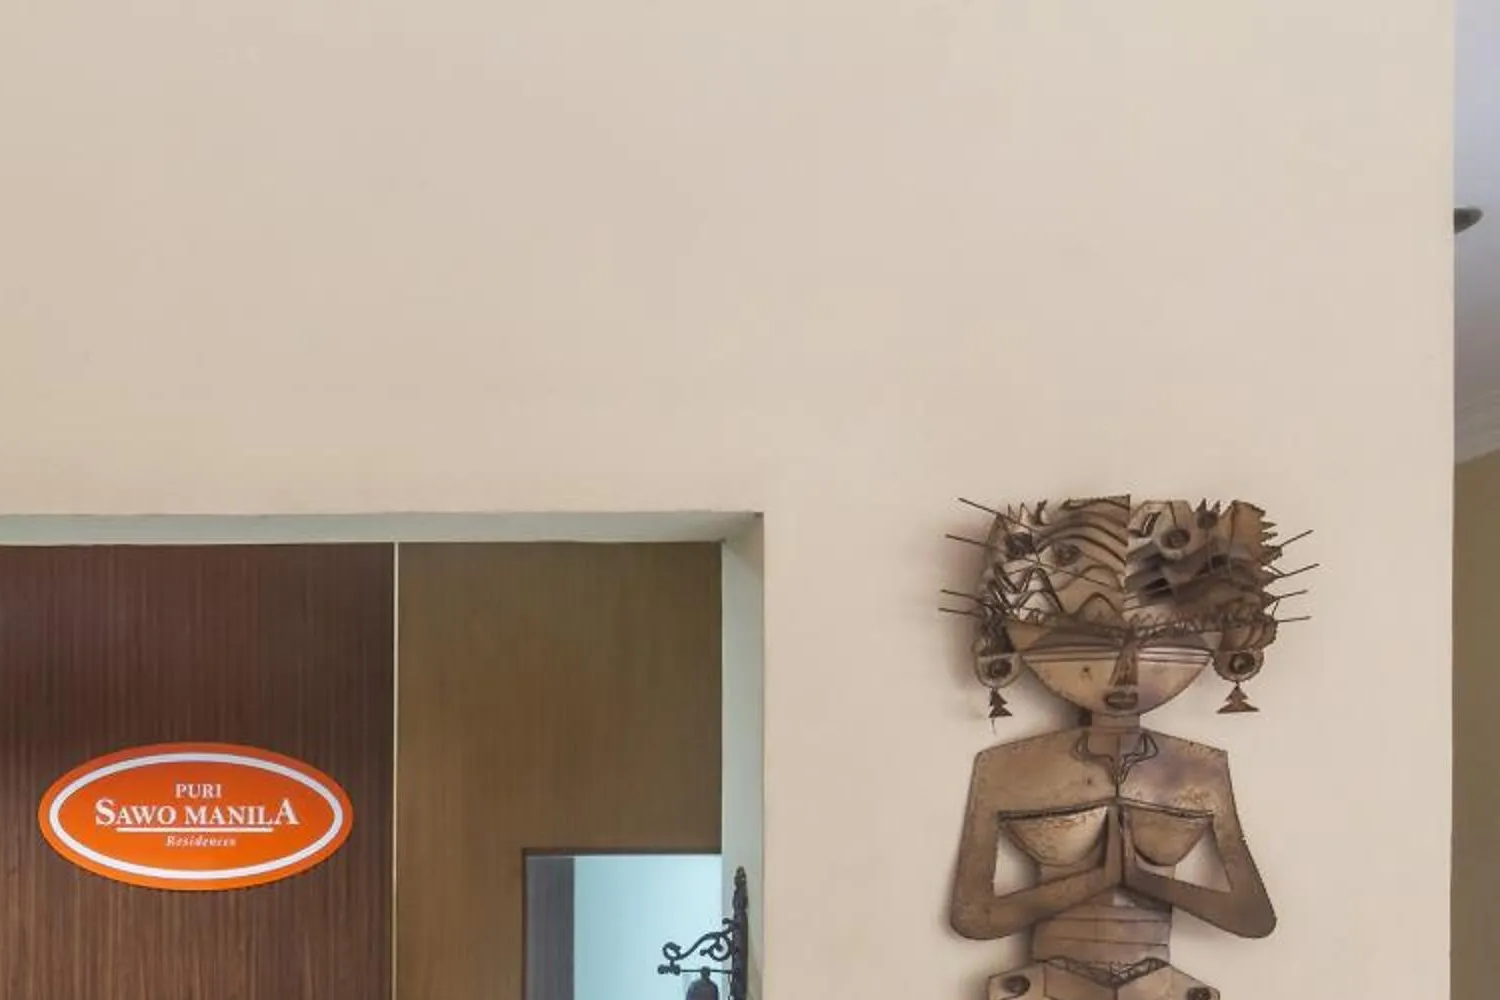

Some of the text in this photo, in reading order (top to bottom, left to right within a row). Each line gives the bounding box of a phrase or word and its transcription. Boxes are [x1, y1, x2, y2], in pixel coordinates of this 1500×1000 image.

[175, 783, 222, 799] PURI
[95, 799, 300, 826] SAWO MANILA
[165, 834, 237, 848] Residences
